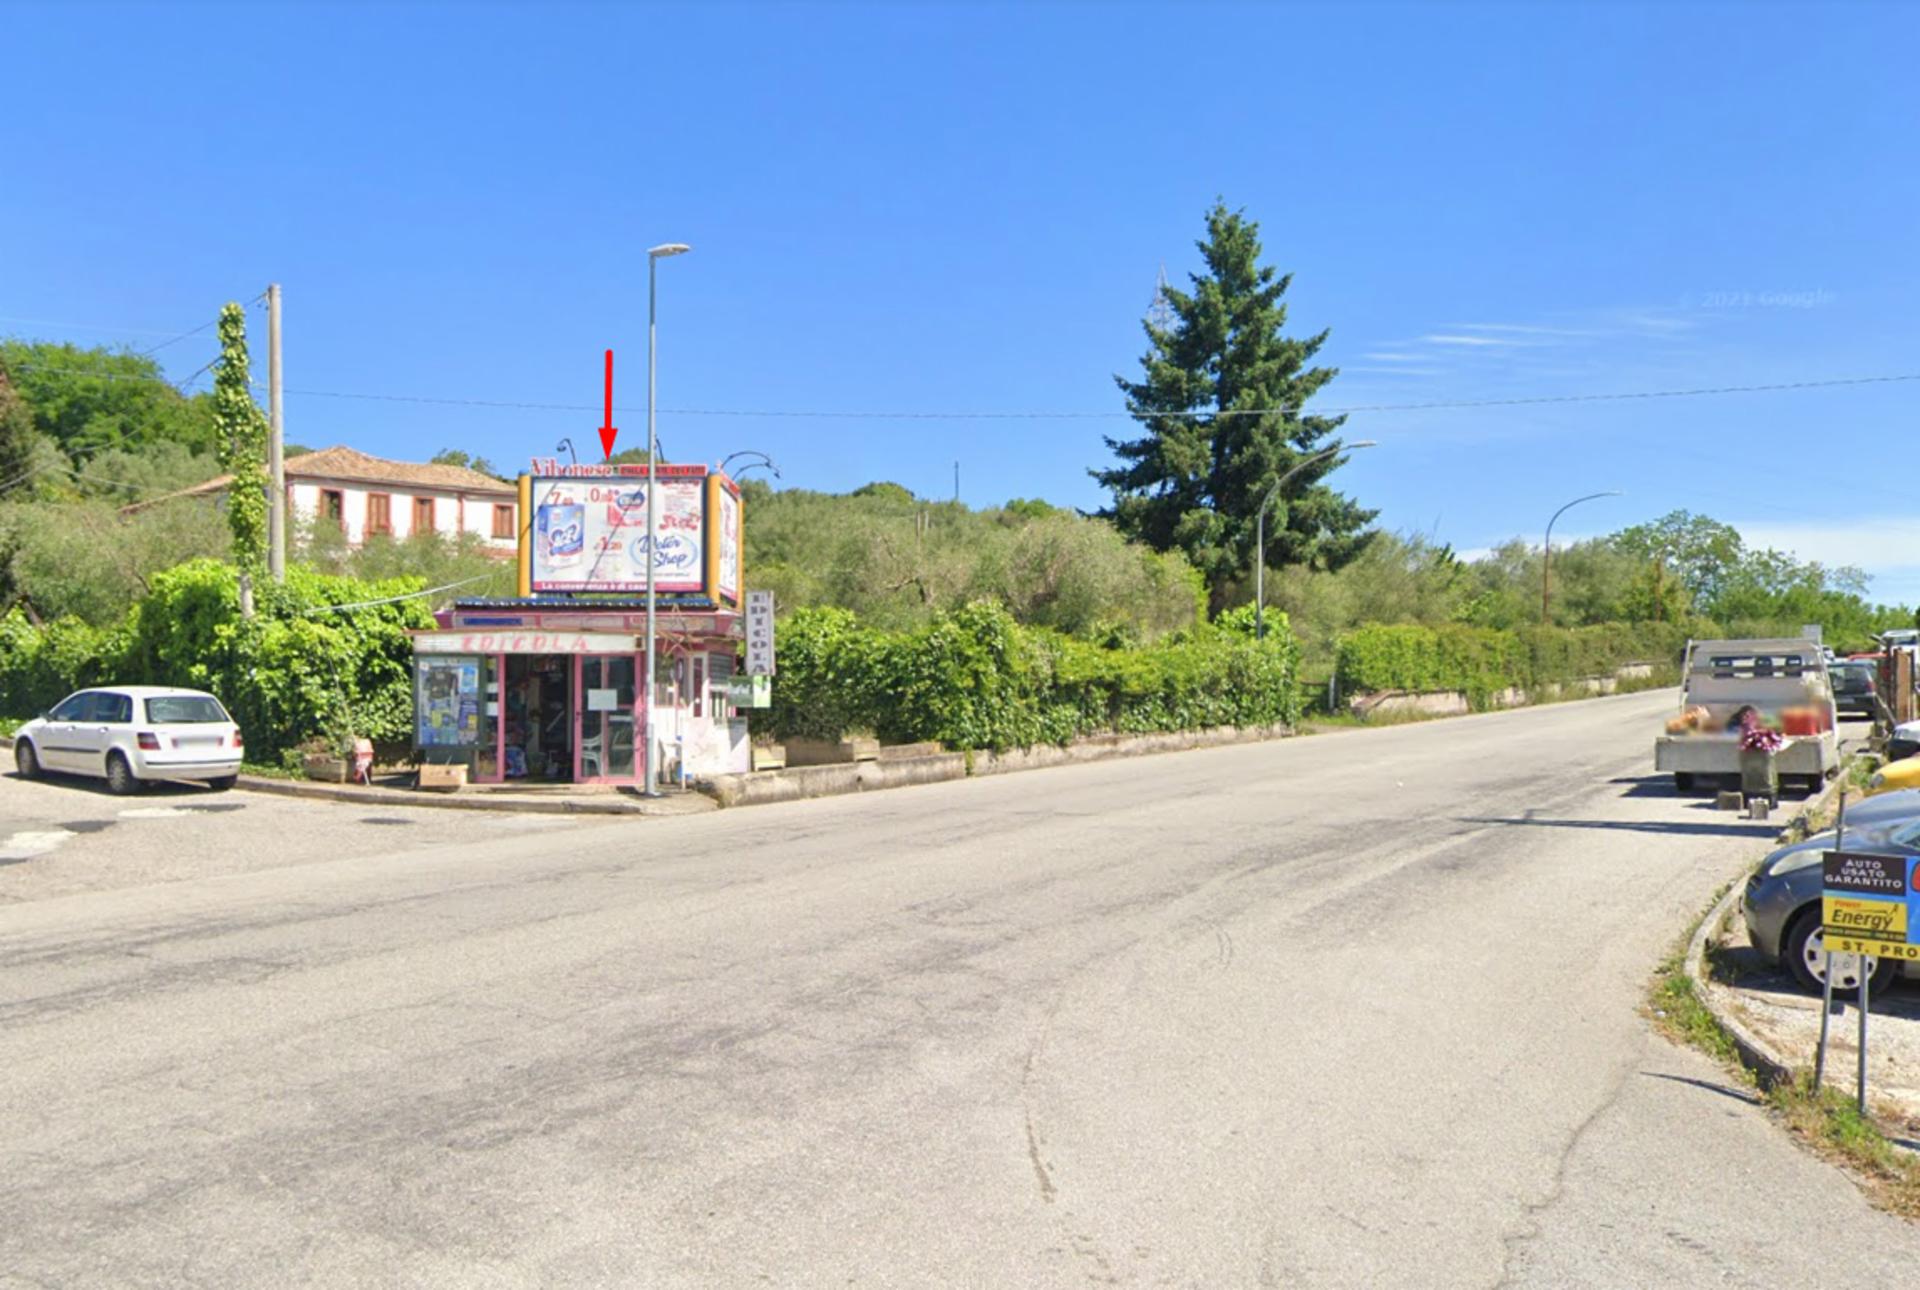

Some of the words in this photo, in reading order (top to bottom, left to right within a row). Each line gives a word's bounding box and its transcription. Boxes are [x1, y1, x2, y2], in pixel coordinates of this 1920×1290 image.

[653, 551, 688, 568] Shop
[751, 594, 768, 673] EDICOLA
[461, 634, 590, 651] EDICOLA
[1841, 867, 1886, 879] USATO
[1845, 859, 1882, 870] AUTO
[1825, 874, 1902, 889] GARANTITO
[1832, 909, 1894, 930] Energy
[1841, 941, 1870, 953] ST.
[1880, 944, 1918, 959] PRO
